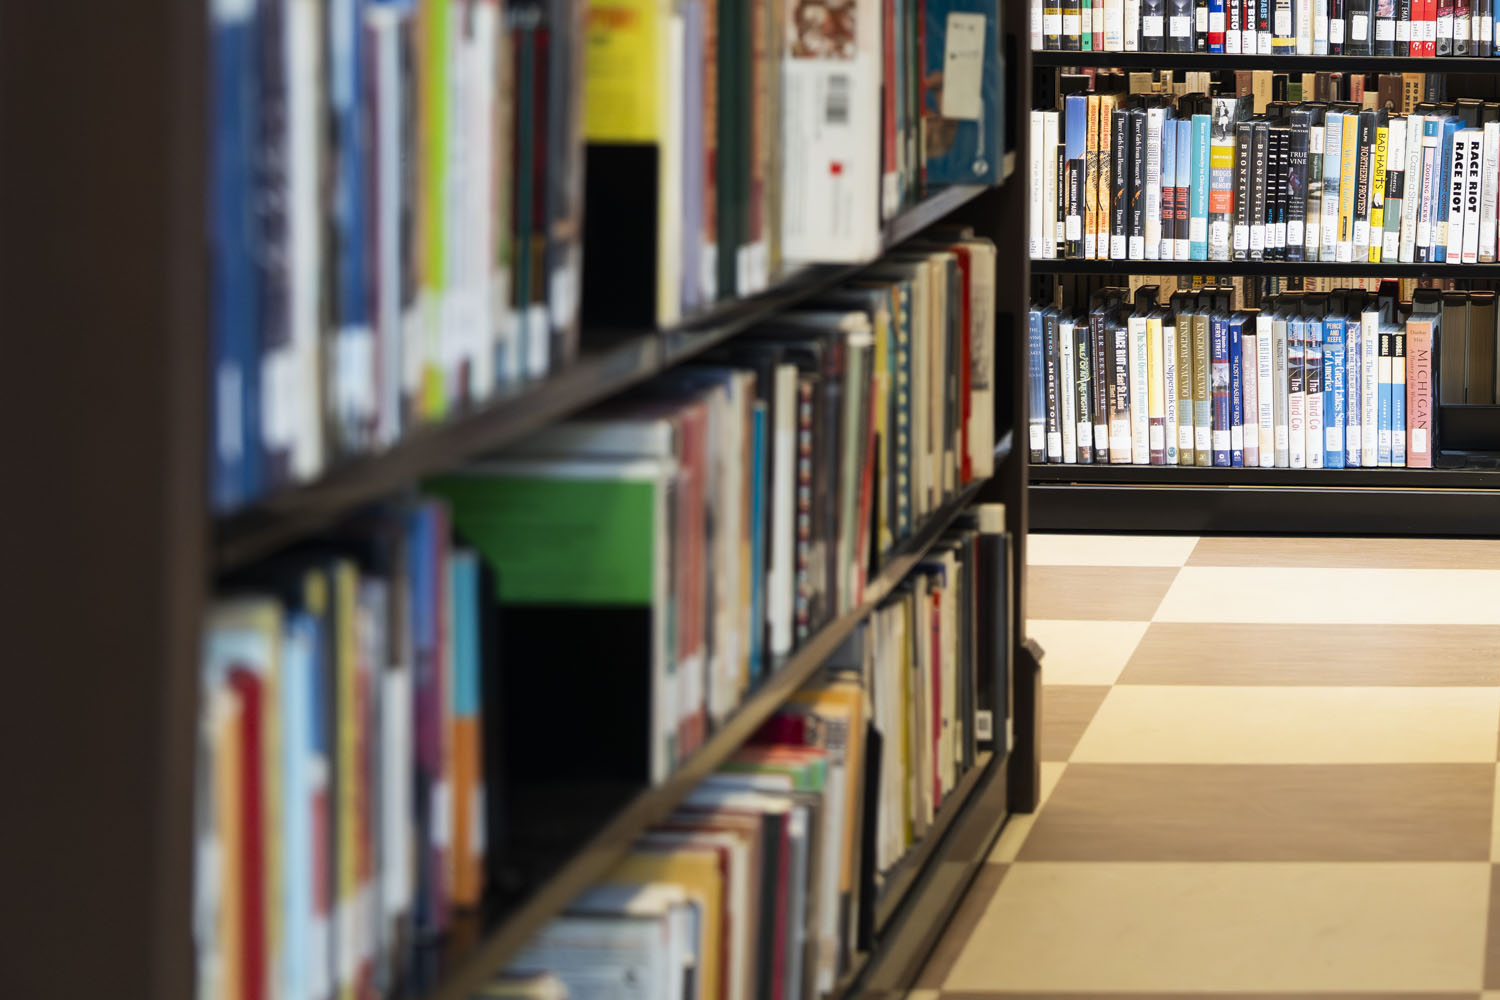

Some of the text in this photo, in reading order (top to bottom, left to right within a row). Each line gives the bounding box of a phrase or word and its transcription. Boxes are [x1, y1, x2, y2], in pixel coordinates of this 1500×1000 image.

[1134, 119, 1142, 134] Three
[1134, 134, 1142, 146] Girls
[1134, 146, 1142, 158] from
[1375, 133, 1386, 189] BAD HABITS
[1134, 159, 1142, 187] Bronzeville
[1357, 146, 1369, 216] NORTHERN PROTEST
[1452, 142, 1464, 213] RACE RIOT
[1468, 141, 1480, 213] RACE RIOT
[1163, 187, 1174, 220] DON'T GO
[1176, 187, 1187, 220] DON'T GO
[1115, 331, 1126, 348] RACE
[1116, 349, 1126, 365] RIOT
[1180, 321, 1189, 397] KINGDOM NAUVOO
[1324, 350, 1334, 392] of America
[1116, 373, 1126, 385] East
[1335, 351, 1345, 411] The Great Lakes
[1417, 349, 1428, 430] MICHIGAN
[1117, 393, 1126, 410] Louis
